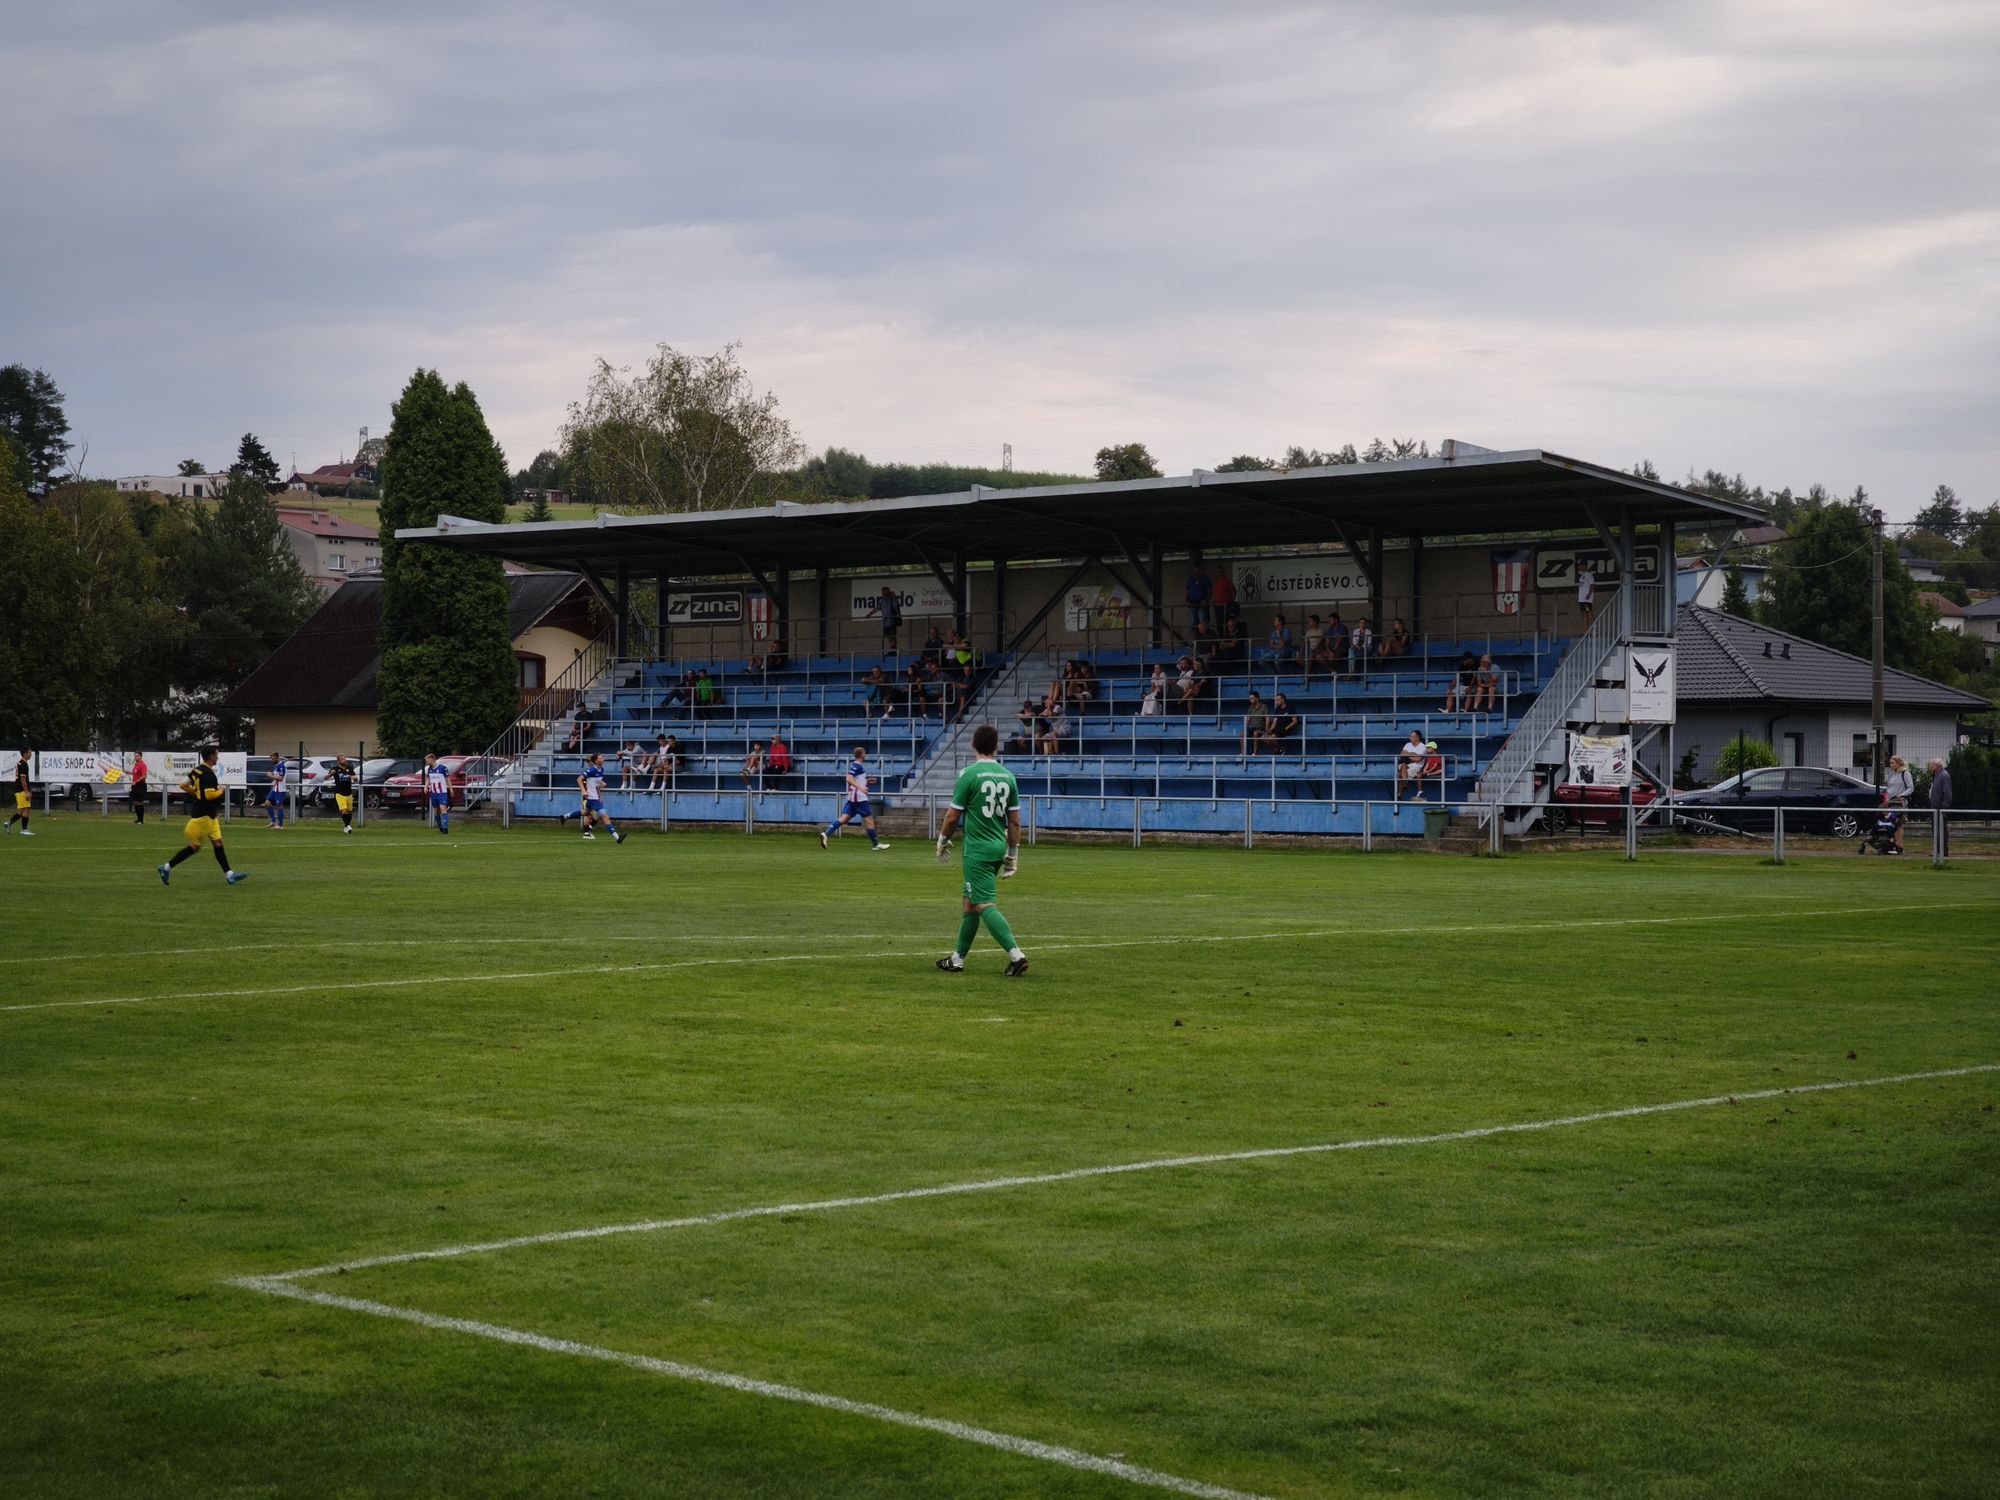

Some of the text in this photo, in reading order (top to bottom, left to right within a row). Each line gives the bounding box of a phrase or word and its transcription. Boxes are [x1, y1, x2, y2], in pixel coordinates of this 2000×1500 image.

[692, 600, 739, 613] zina
[42, 757, 95, 769] JEANS-SHOP.CZ
[981, 780, 1010, 818] 33
